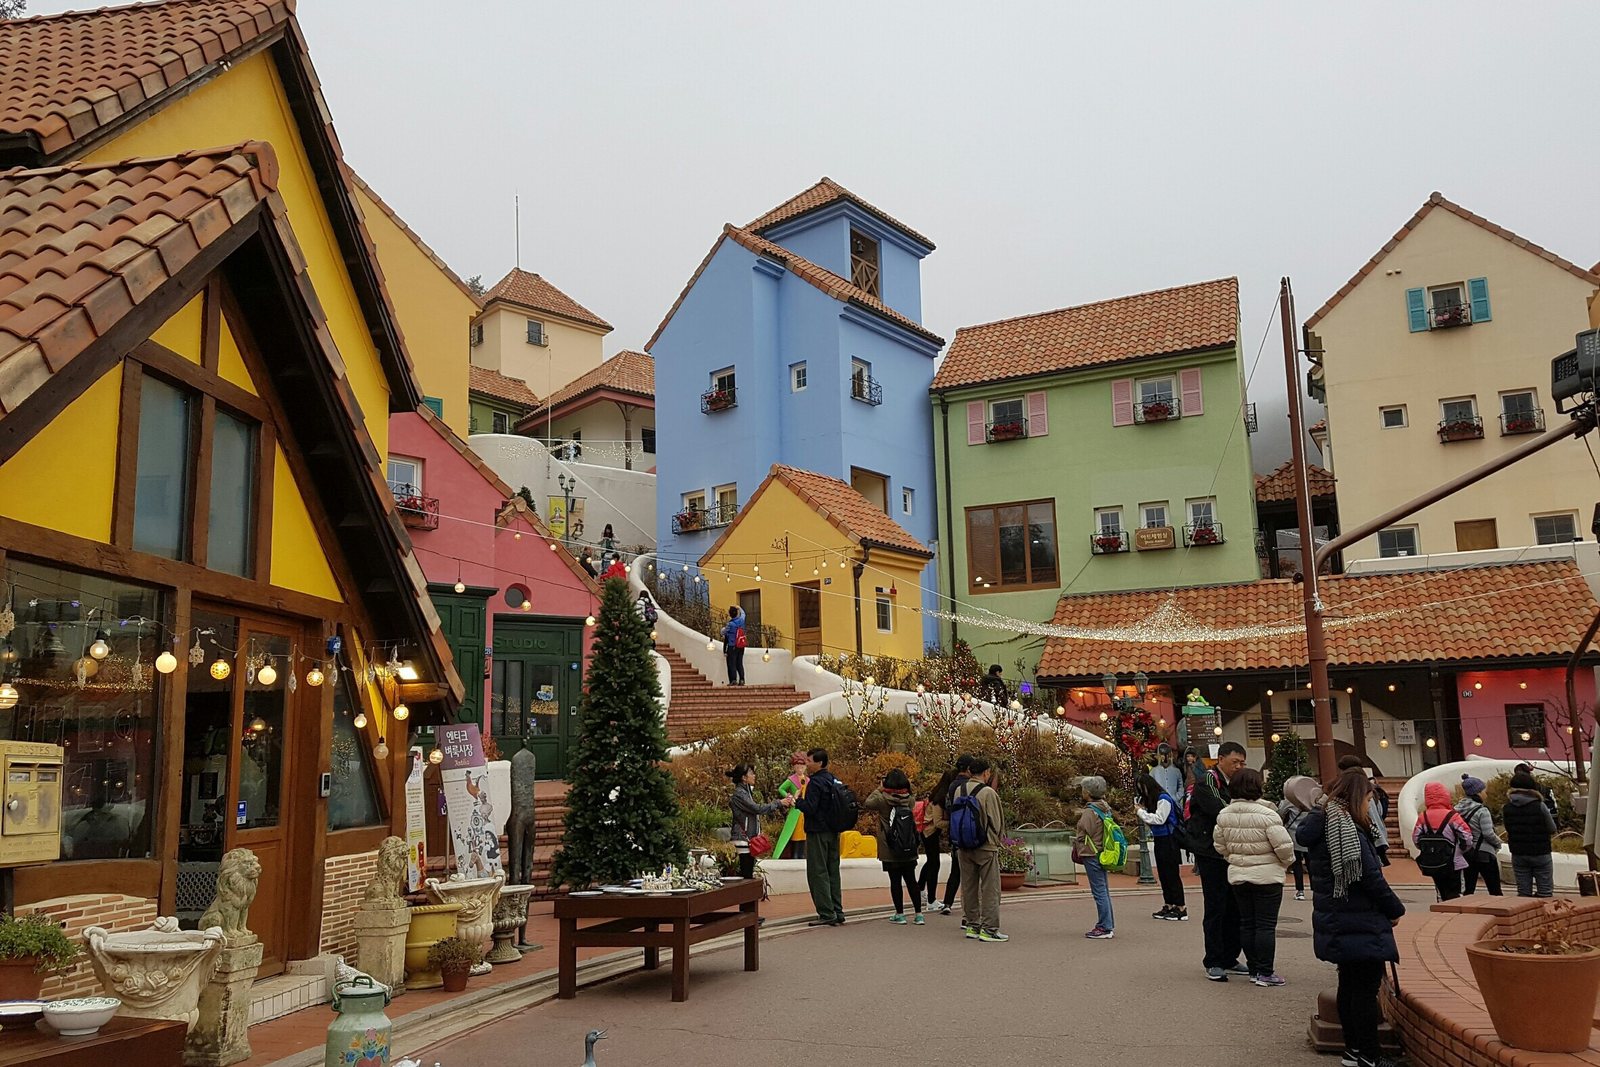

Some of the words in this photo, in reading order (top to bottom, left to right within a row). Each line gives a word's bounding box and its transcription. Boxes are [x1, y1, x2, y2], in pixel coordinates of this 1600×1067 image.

[493, 635, 547, 649] STUDIO
[446, 730, 468, 744] 엔티크
[17, 744, 50, 755] POSTES
[444, 744, 473, 758] 벼룩시장
